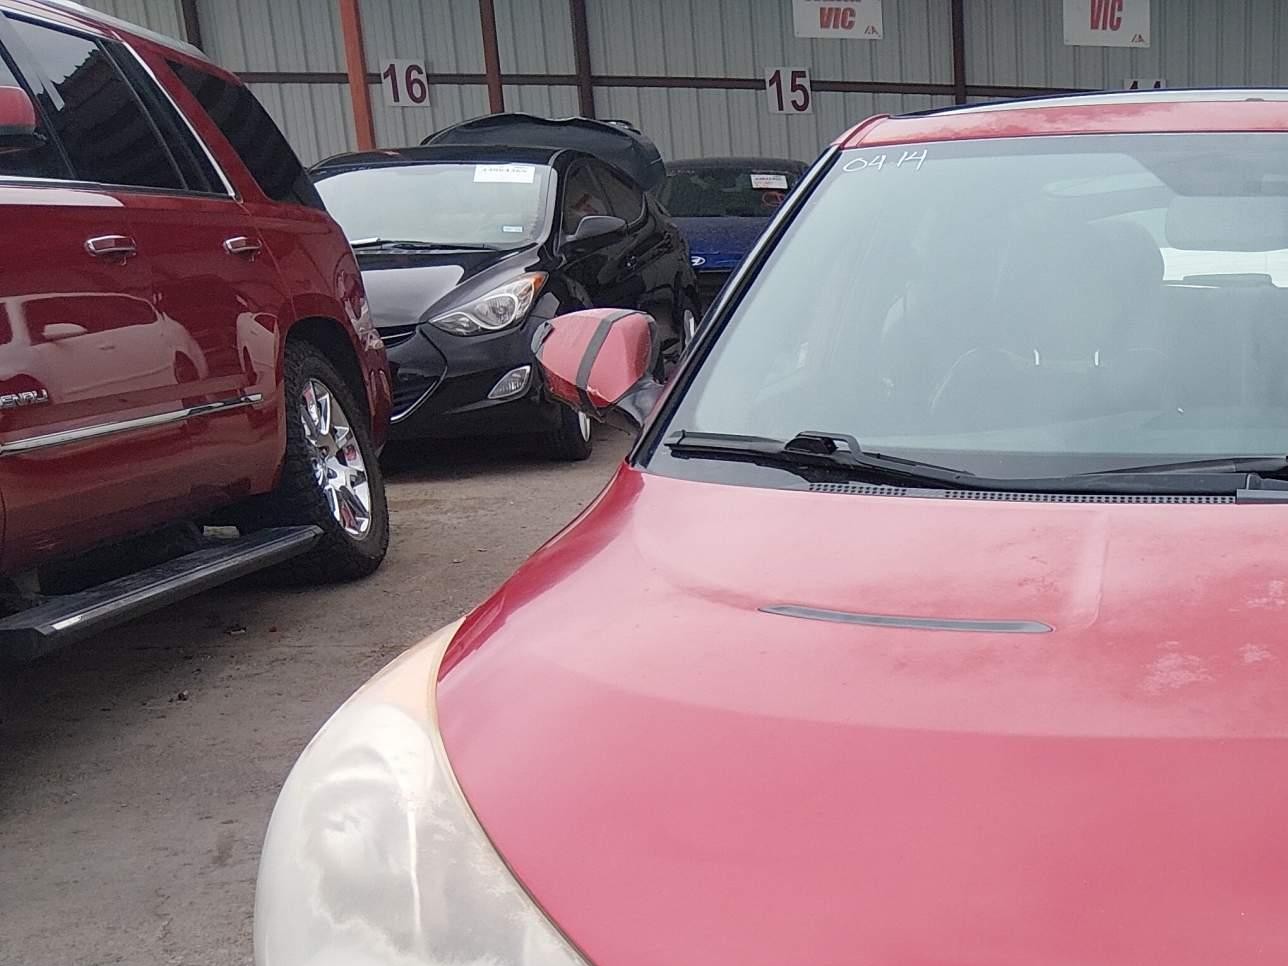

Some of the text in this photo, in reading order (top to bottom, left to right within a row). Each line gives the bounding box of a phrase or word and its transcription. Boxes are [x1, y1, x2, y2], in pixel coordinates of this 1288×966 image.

[819, 7, 856, 30] VIC
[1090, 0, 1123, 30] VIC
[383, 63, 427, 104] 16
[768, 69, 810, 111] 15
